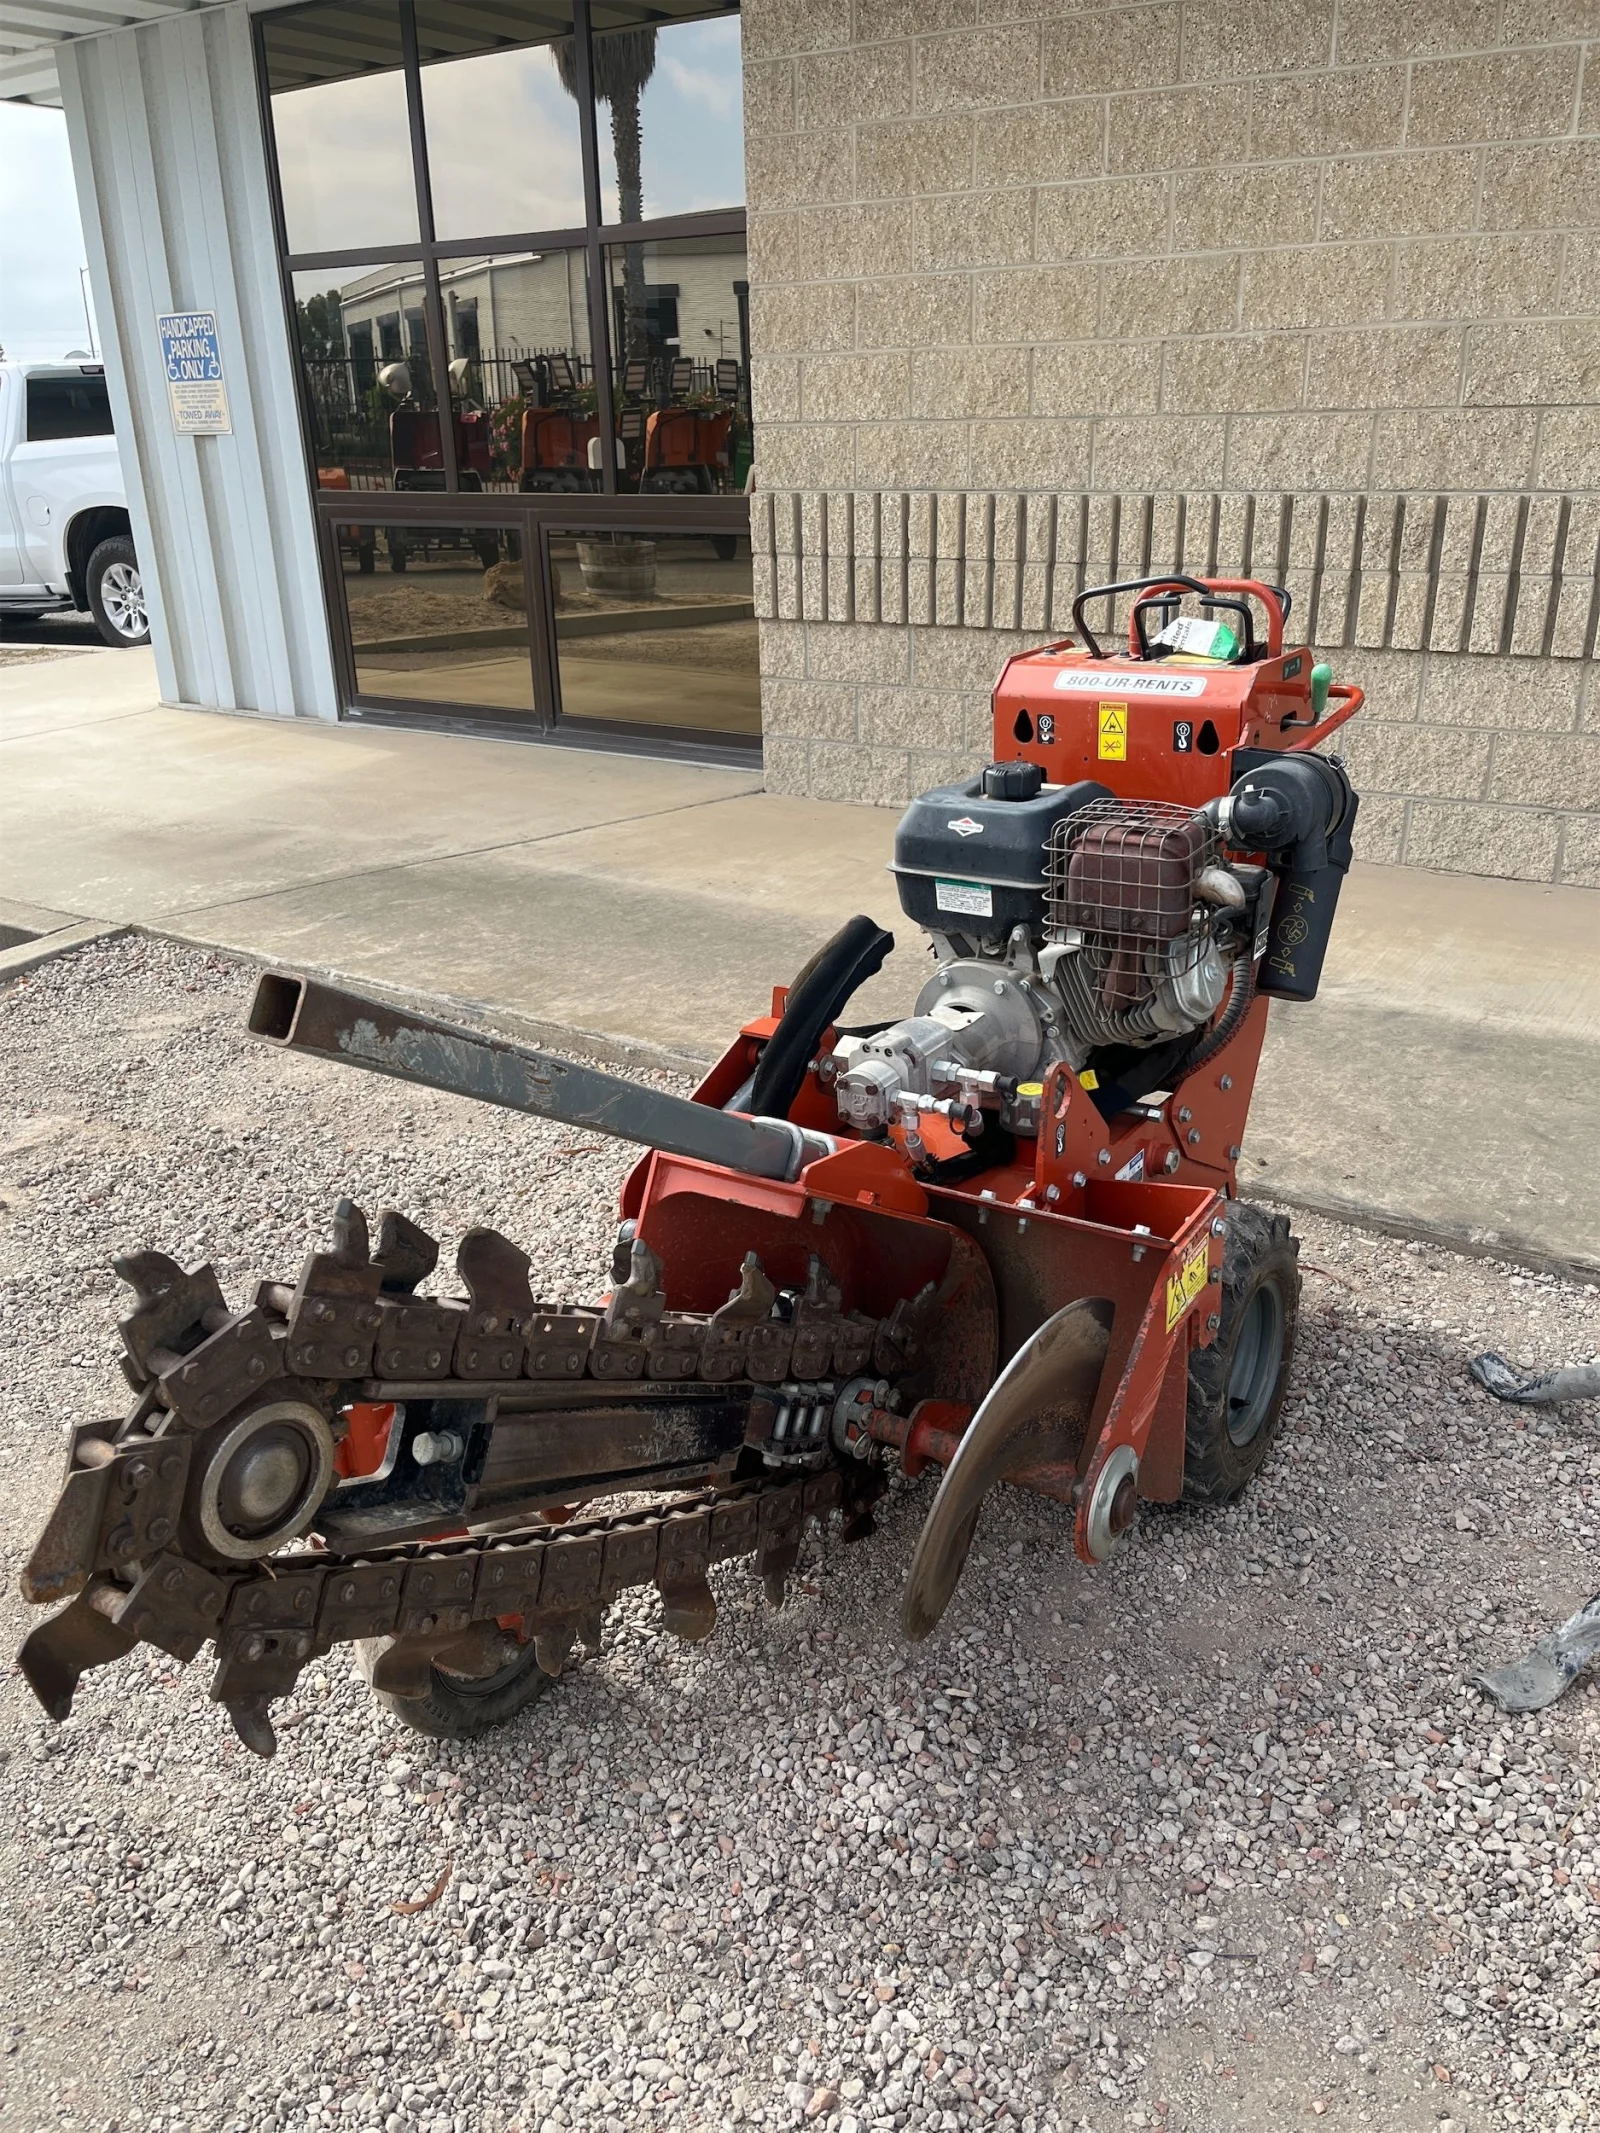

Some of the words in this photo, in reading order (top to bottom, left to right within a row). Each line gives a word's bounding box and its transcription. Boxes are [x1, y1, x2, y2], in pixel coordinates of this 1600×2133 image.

[160, 316, 214, 338] HANDICAPPED
[170, 338, 210, 359] PARKING
[180, 360, 205, 379] ONLY
[179, 410, 202, 420] TOWED
[204, 410, 222, 419] AWAY
[1170, 621, 1185, 648] nited
[1178, 620, 1193, 650] entals
[1066, 675, 1194, 692] 800-UR-RENTS
